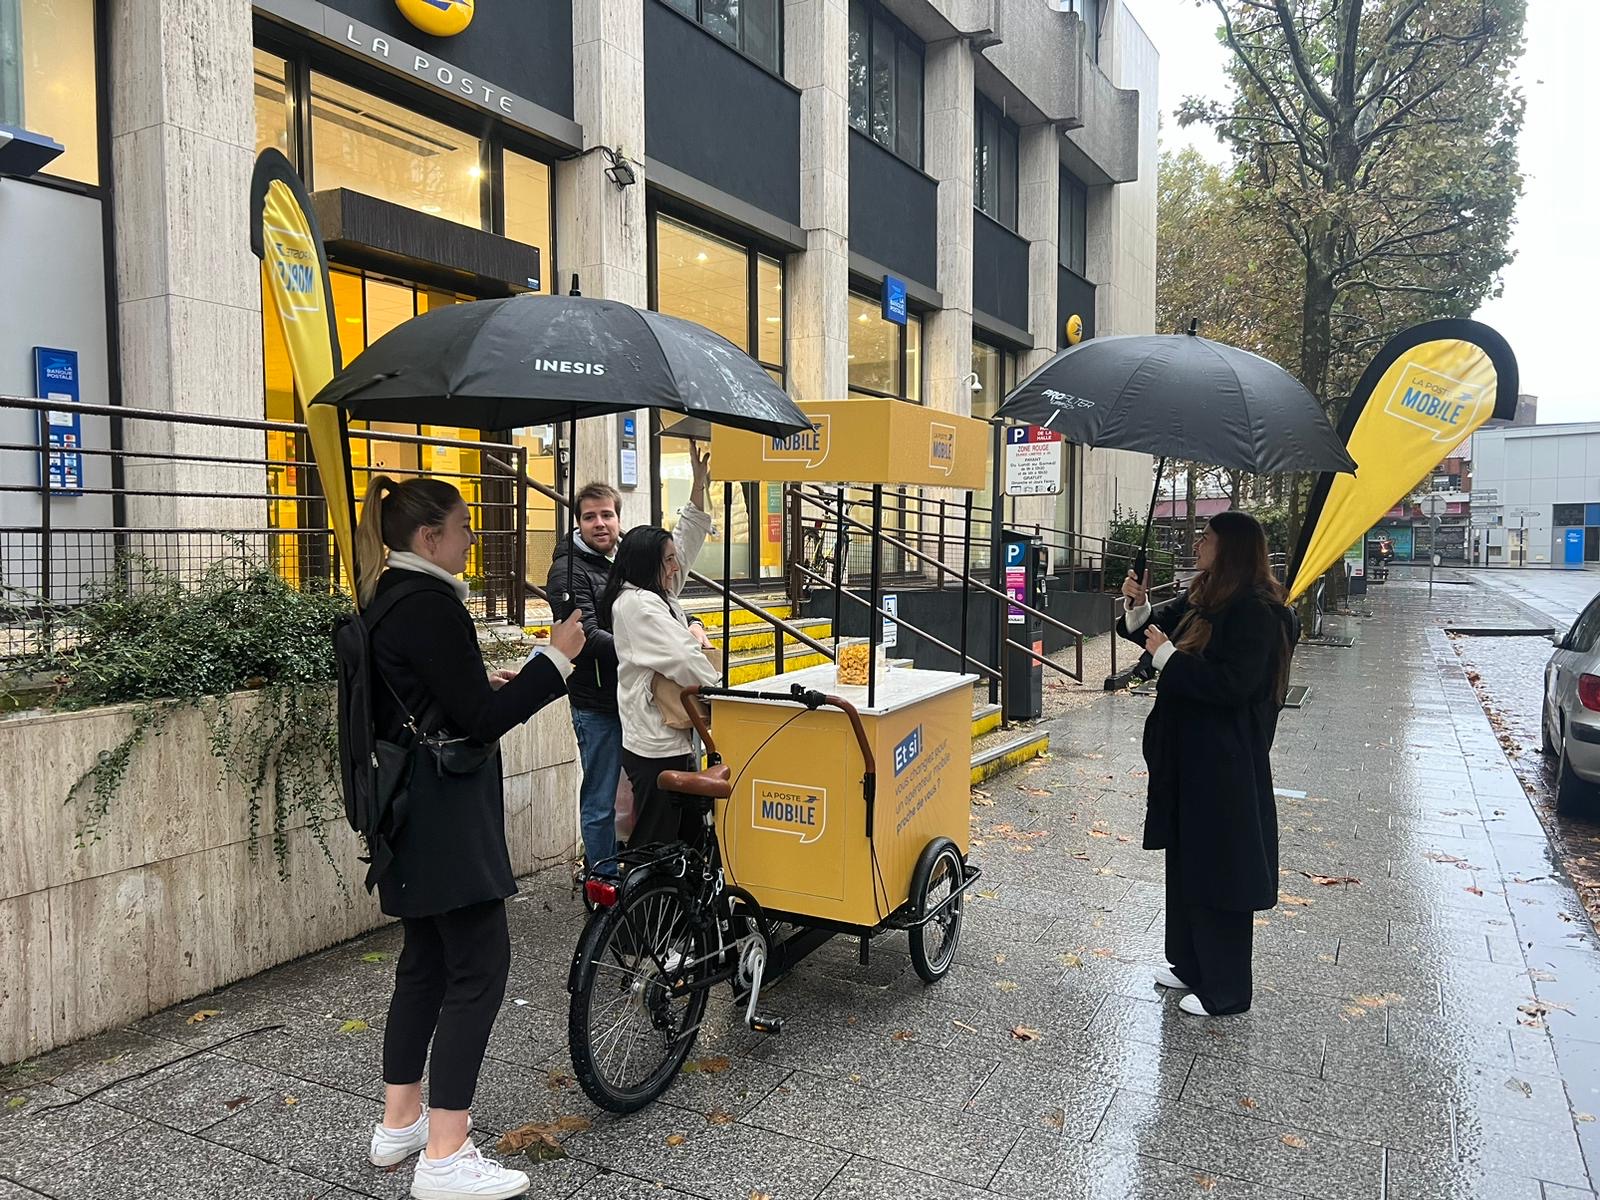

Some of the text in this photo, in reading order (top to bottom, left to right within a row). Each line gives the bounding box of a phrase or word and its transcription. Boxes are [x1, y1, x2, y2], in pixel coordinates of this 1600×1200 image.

[346, 24, 513, 113] LA POSTE
[534, 358, 605, 376] INESIS
[1412, 377, 1424, 386] LA
[1014, 429, 1024, 443] P
[1007, 544, 1020, 563] P
[895, 745, 907, 771] Et
[909, 733, 917, 757] si
[762, 790, 801, 802] LA POSTE
[762, 800, 815, 825] MOB!LE
[896, 806, 916, 836] proche
[917, 798, 924, 811] de
